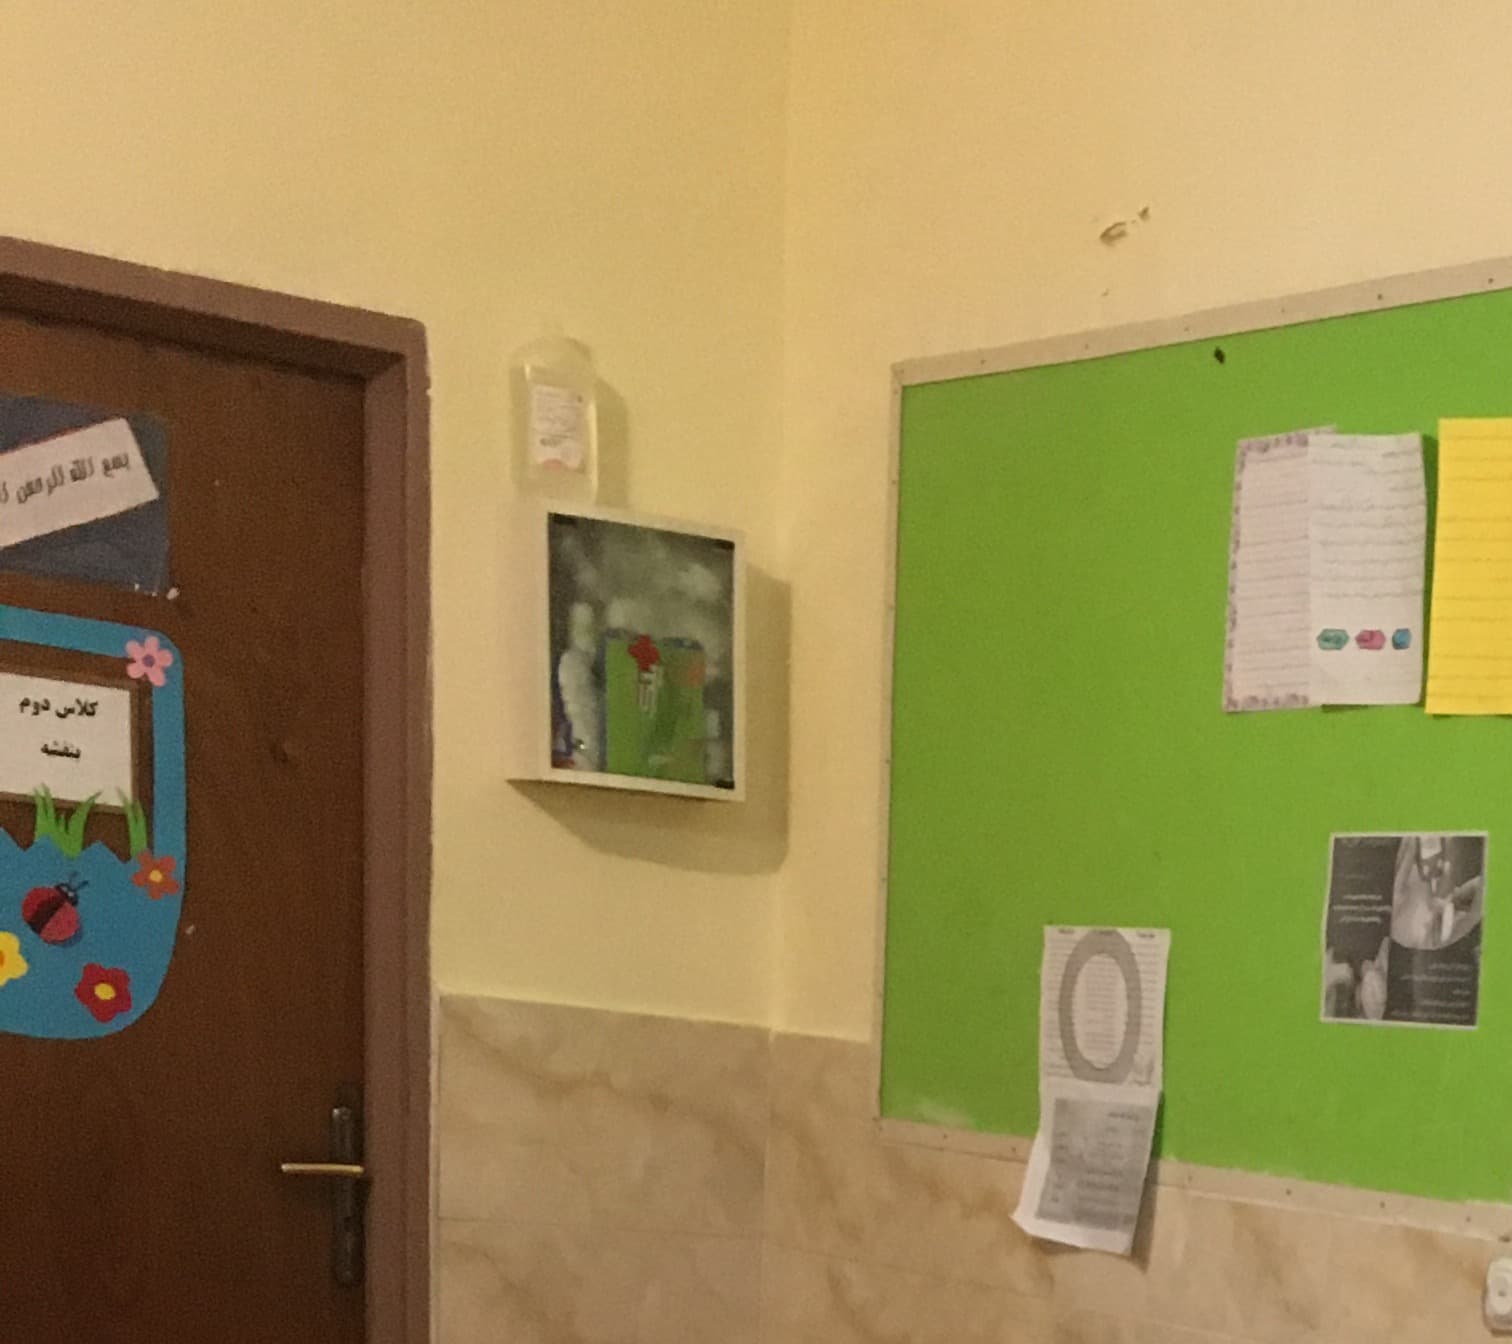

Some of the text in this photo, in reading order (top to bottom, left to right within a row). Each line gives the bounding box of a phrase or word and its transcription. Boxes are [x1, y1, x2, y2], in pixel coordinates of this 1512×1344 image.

[70, 457, 95, 482] الله
[102, 453, 129, 478] بسم
[19, 696, 99, 719] کلاس دوم
